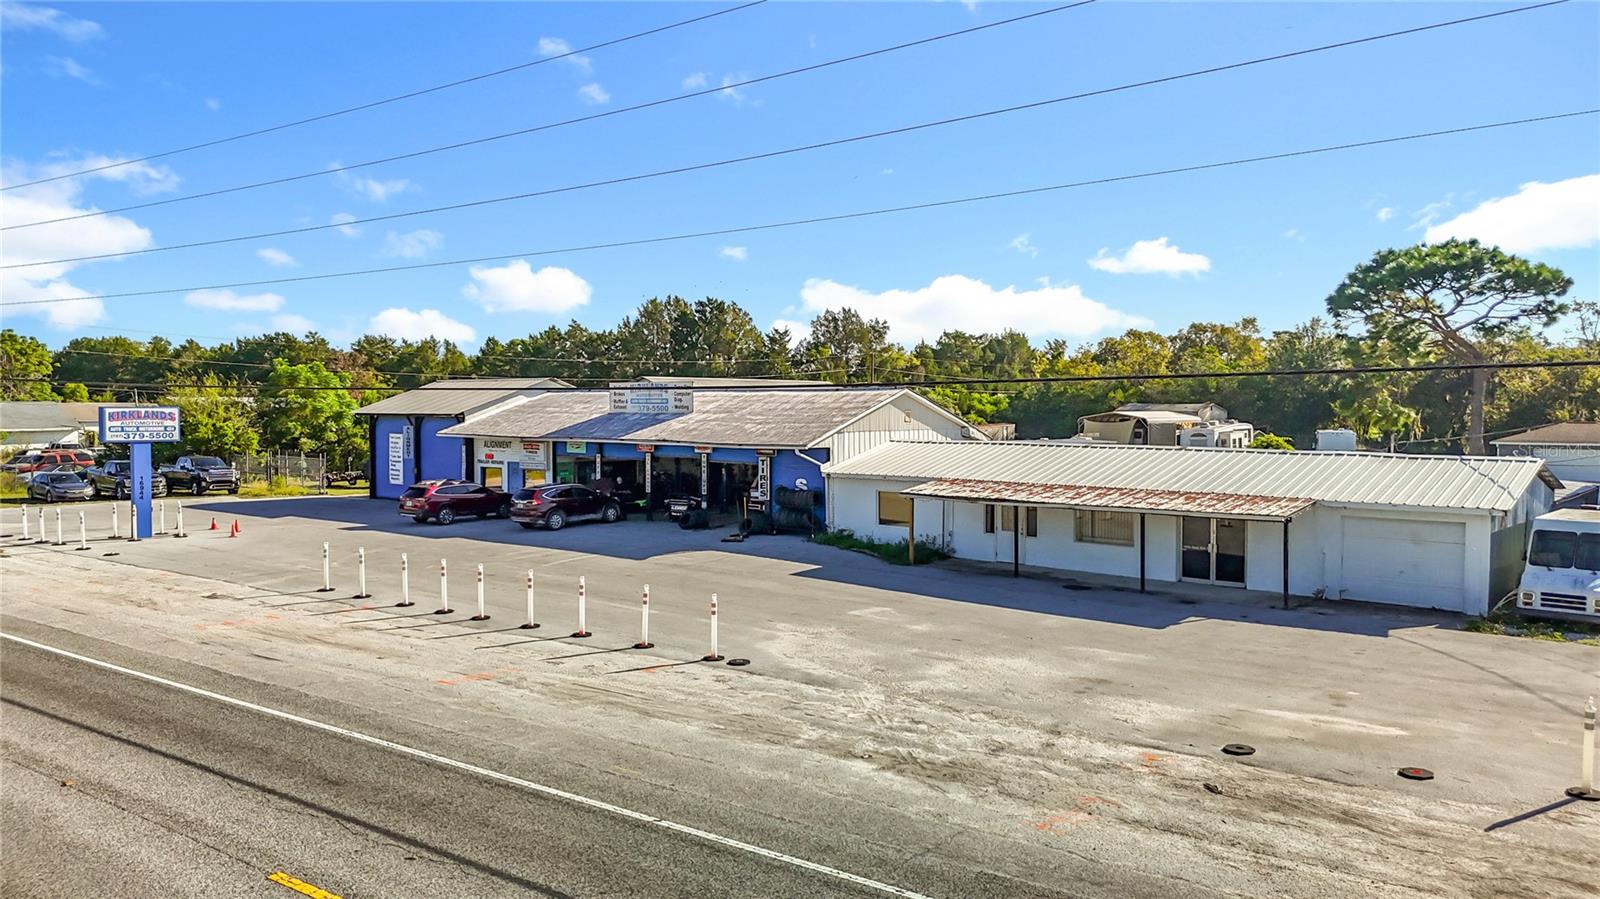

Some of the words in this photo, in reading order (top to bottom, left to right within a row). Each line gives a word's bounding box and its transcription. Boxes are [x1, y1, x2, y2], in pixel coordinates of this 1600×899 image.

[108, 410, 177, 422] KIRKLANDS
[123, 432, 174, 440] 379-5500
[483, 440, 512, 449] ALIGNMENT
